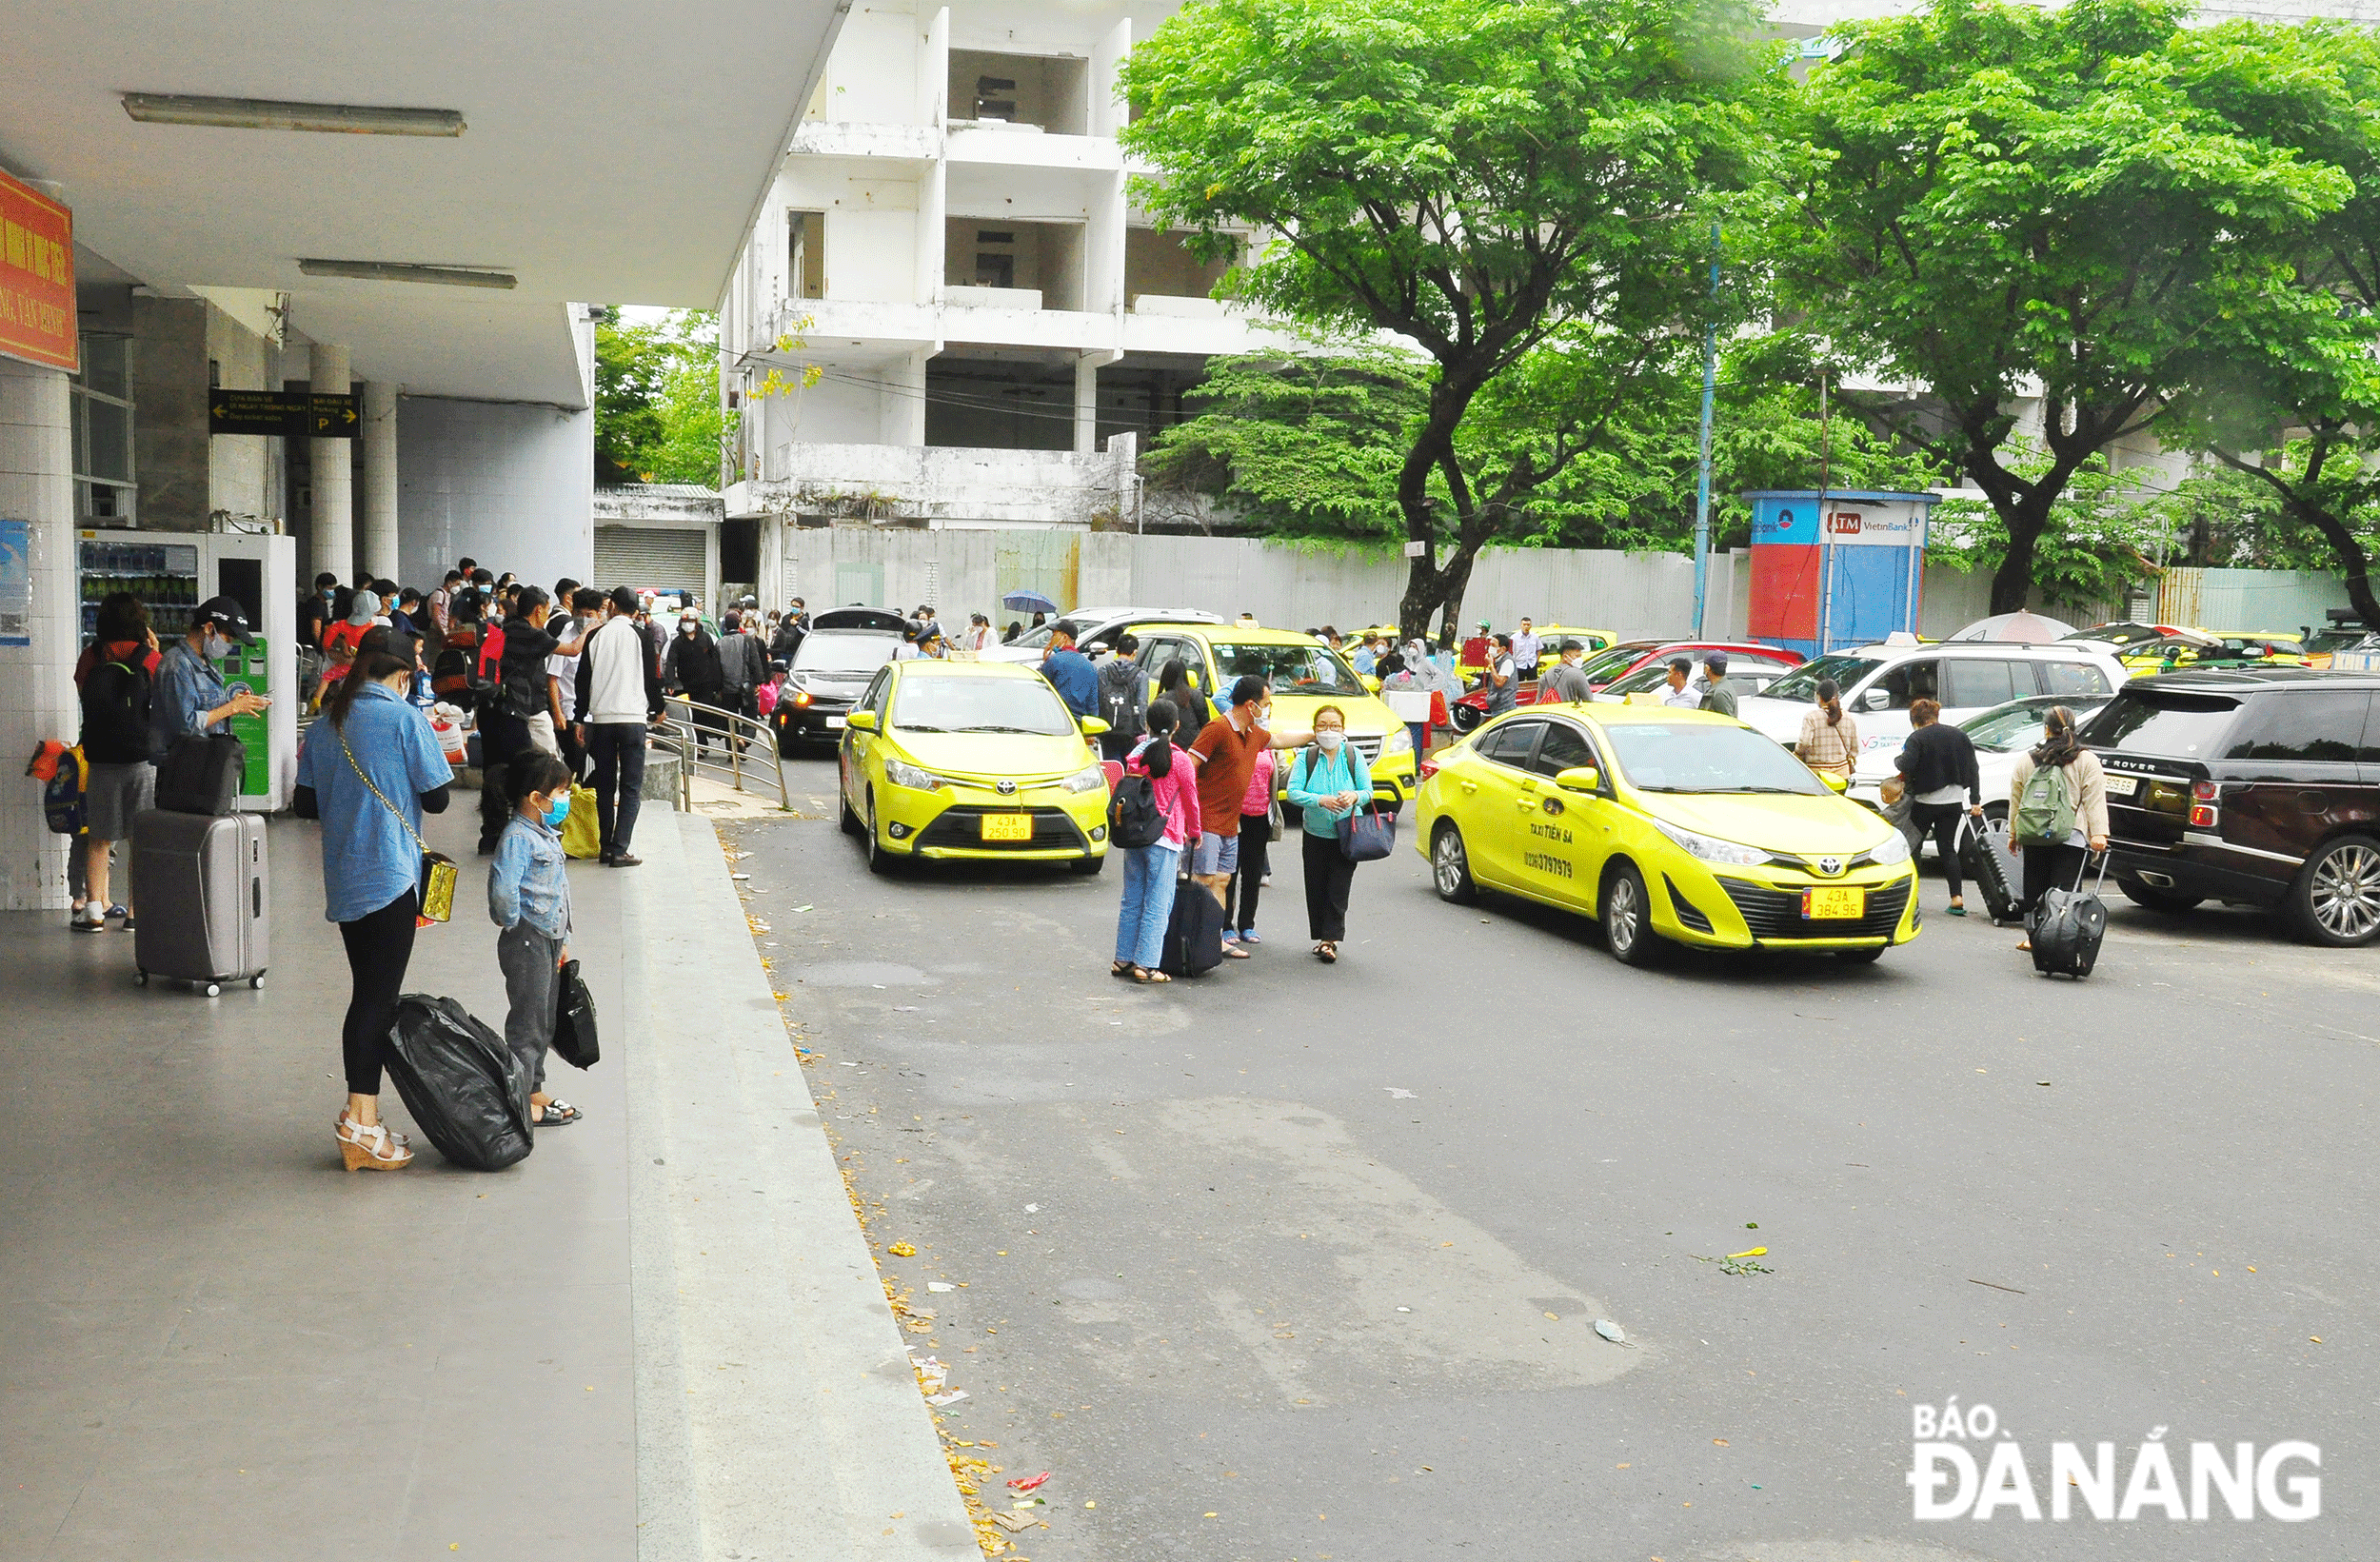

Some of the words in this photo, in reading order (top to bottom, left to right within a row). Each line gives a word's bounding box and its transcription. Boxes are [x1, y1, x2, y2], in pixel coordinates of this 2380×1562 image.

[318, 418, 329, 429] P
[1863, 522, 1908, 532] VietinBank
[2113, 760, 2156, 772] ROVER
[997, 816, 1017, 826] 43A
[1562, 829, 1574, 845] SA
[1826, 889, 1849, 902] 43A
[1816, 903, 1857, 917] 384.96
